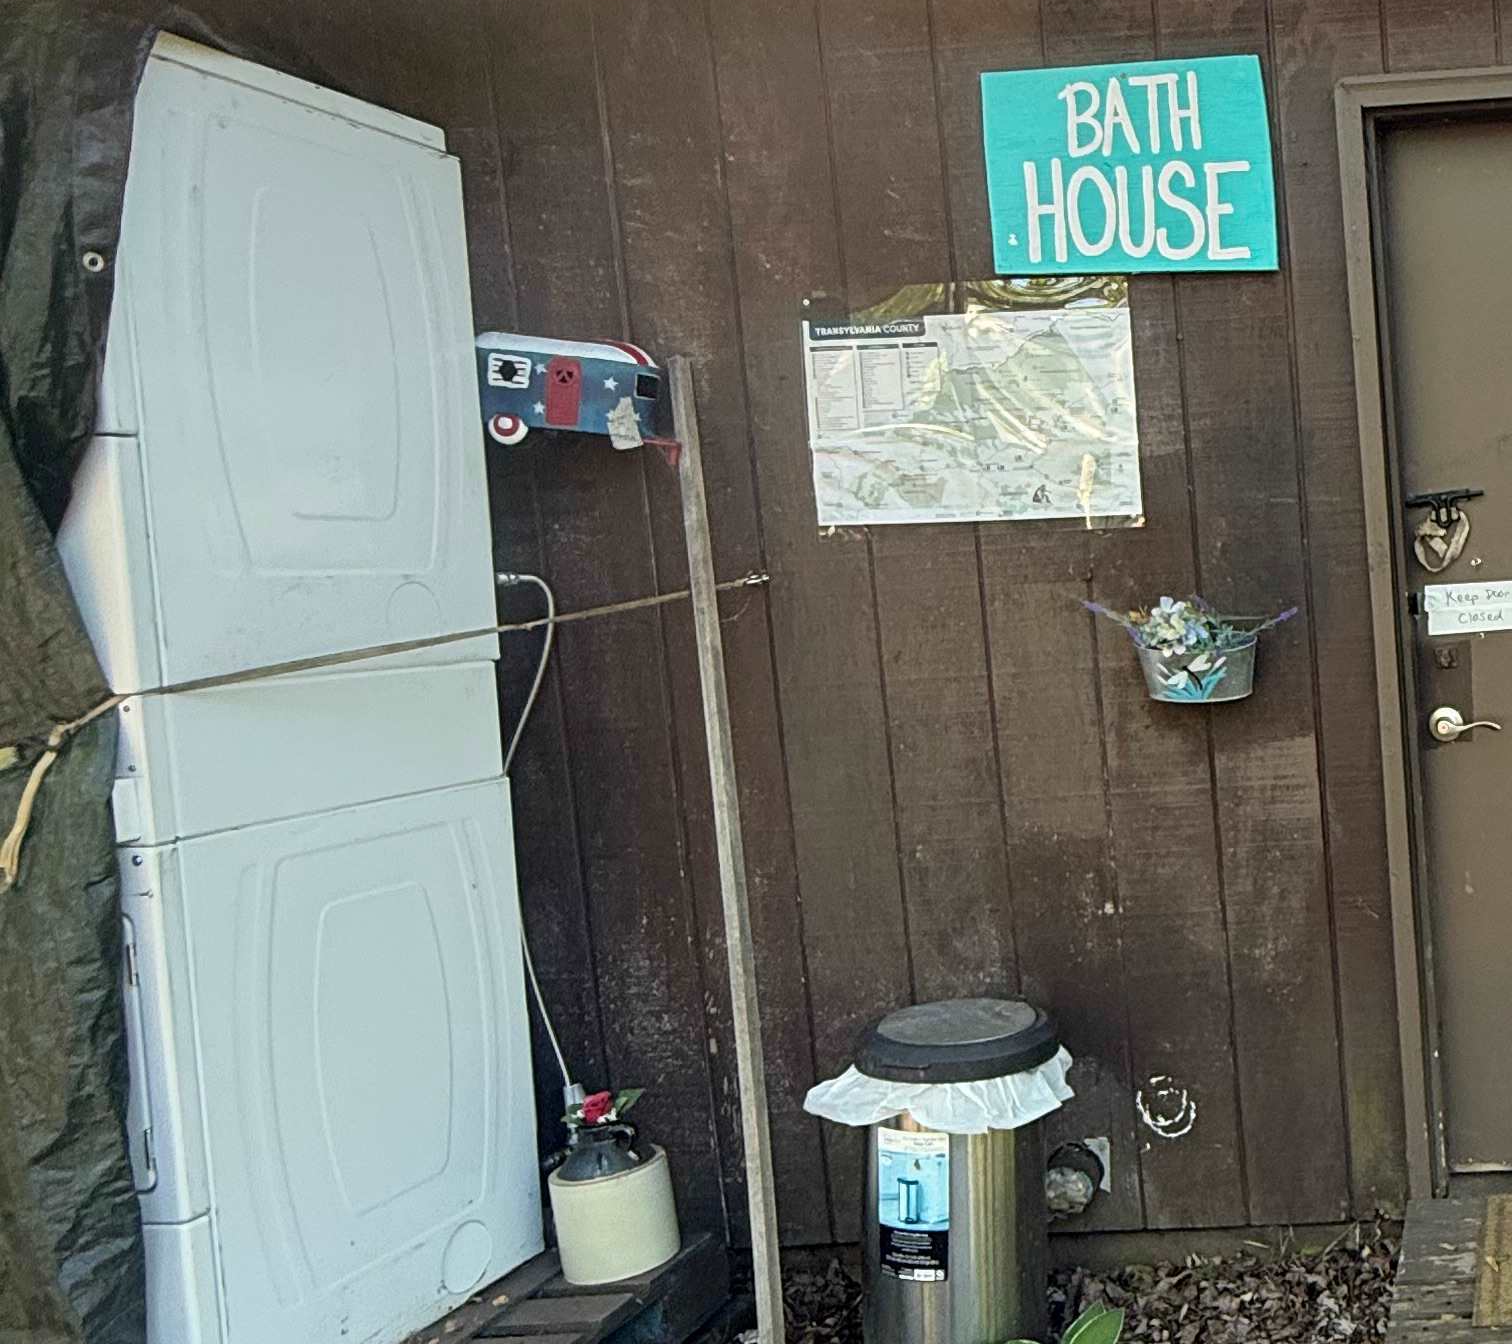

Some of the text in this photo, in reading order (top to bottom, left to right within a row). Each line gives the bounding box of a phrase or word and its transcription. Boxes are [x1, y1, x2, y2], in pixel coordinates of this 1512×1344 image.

[1058, 71, 1201, 157] BATH
[1023, 158, 1250, 263] HOUSE
[814, 322, 920, 337] TRANSYLVANIA COUNTY
[1445, 591, 1479, 607] Keep
[1457, 608, 1504, 624] Closed
